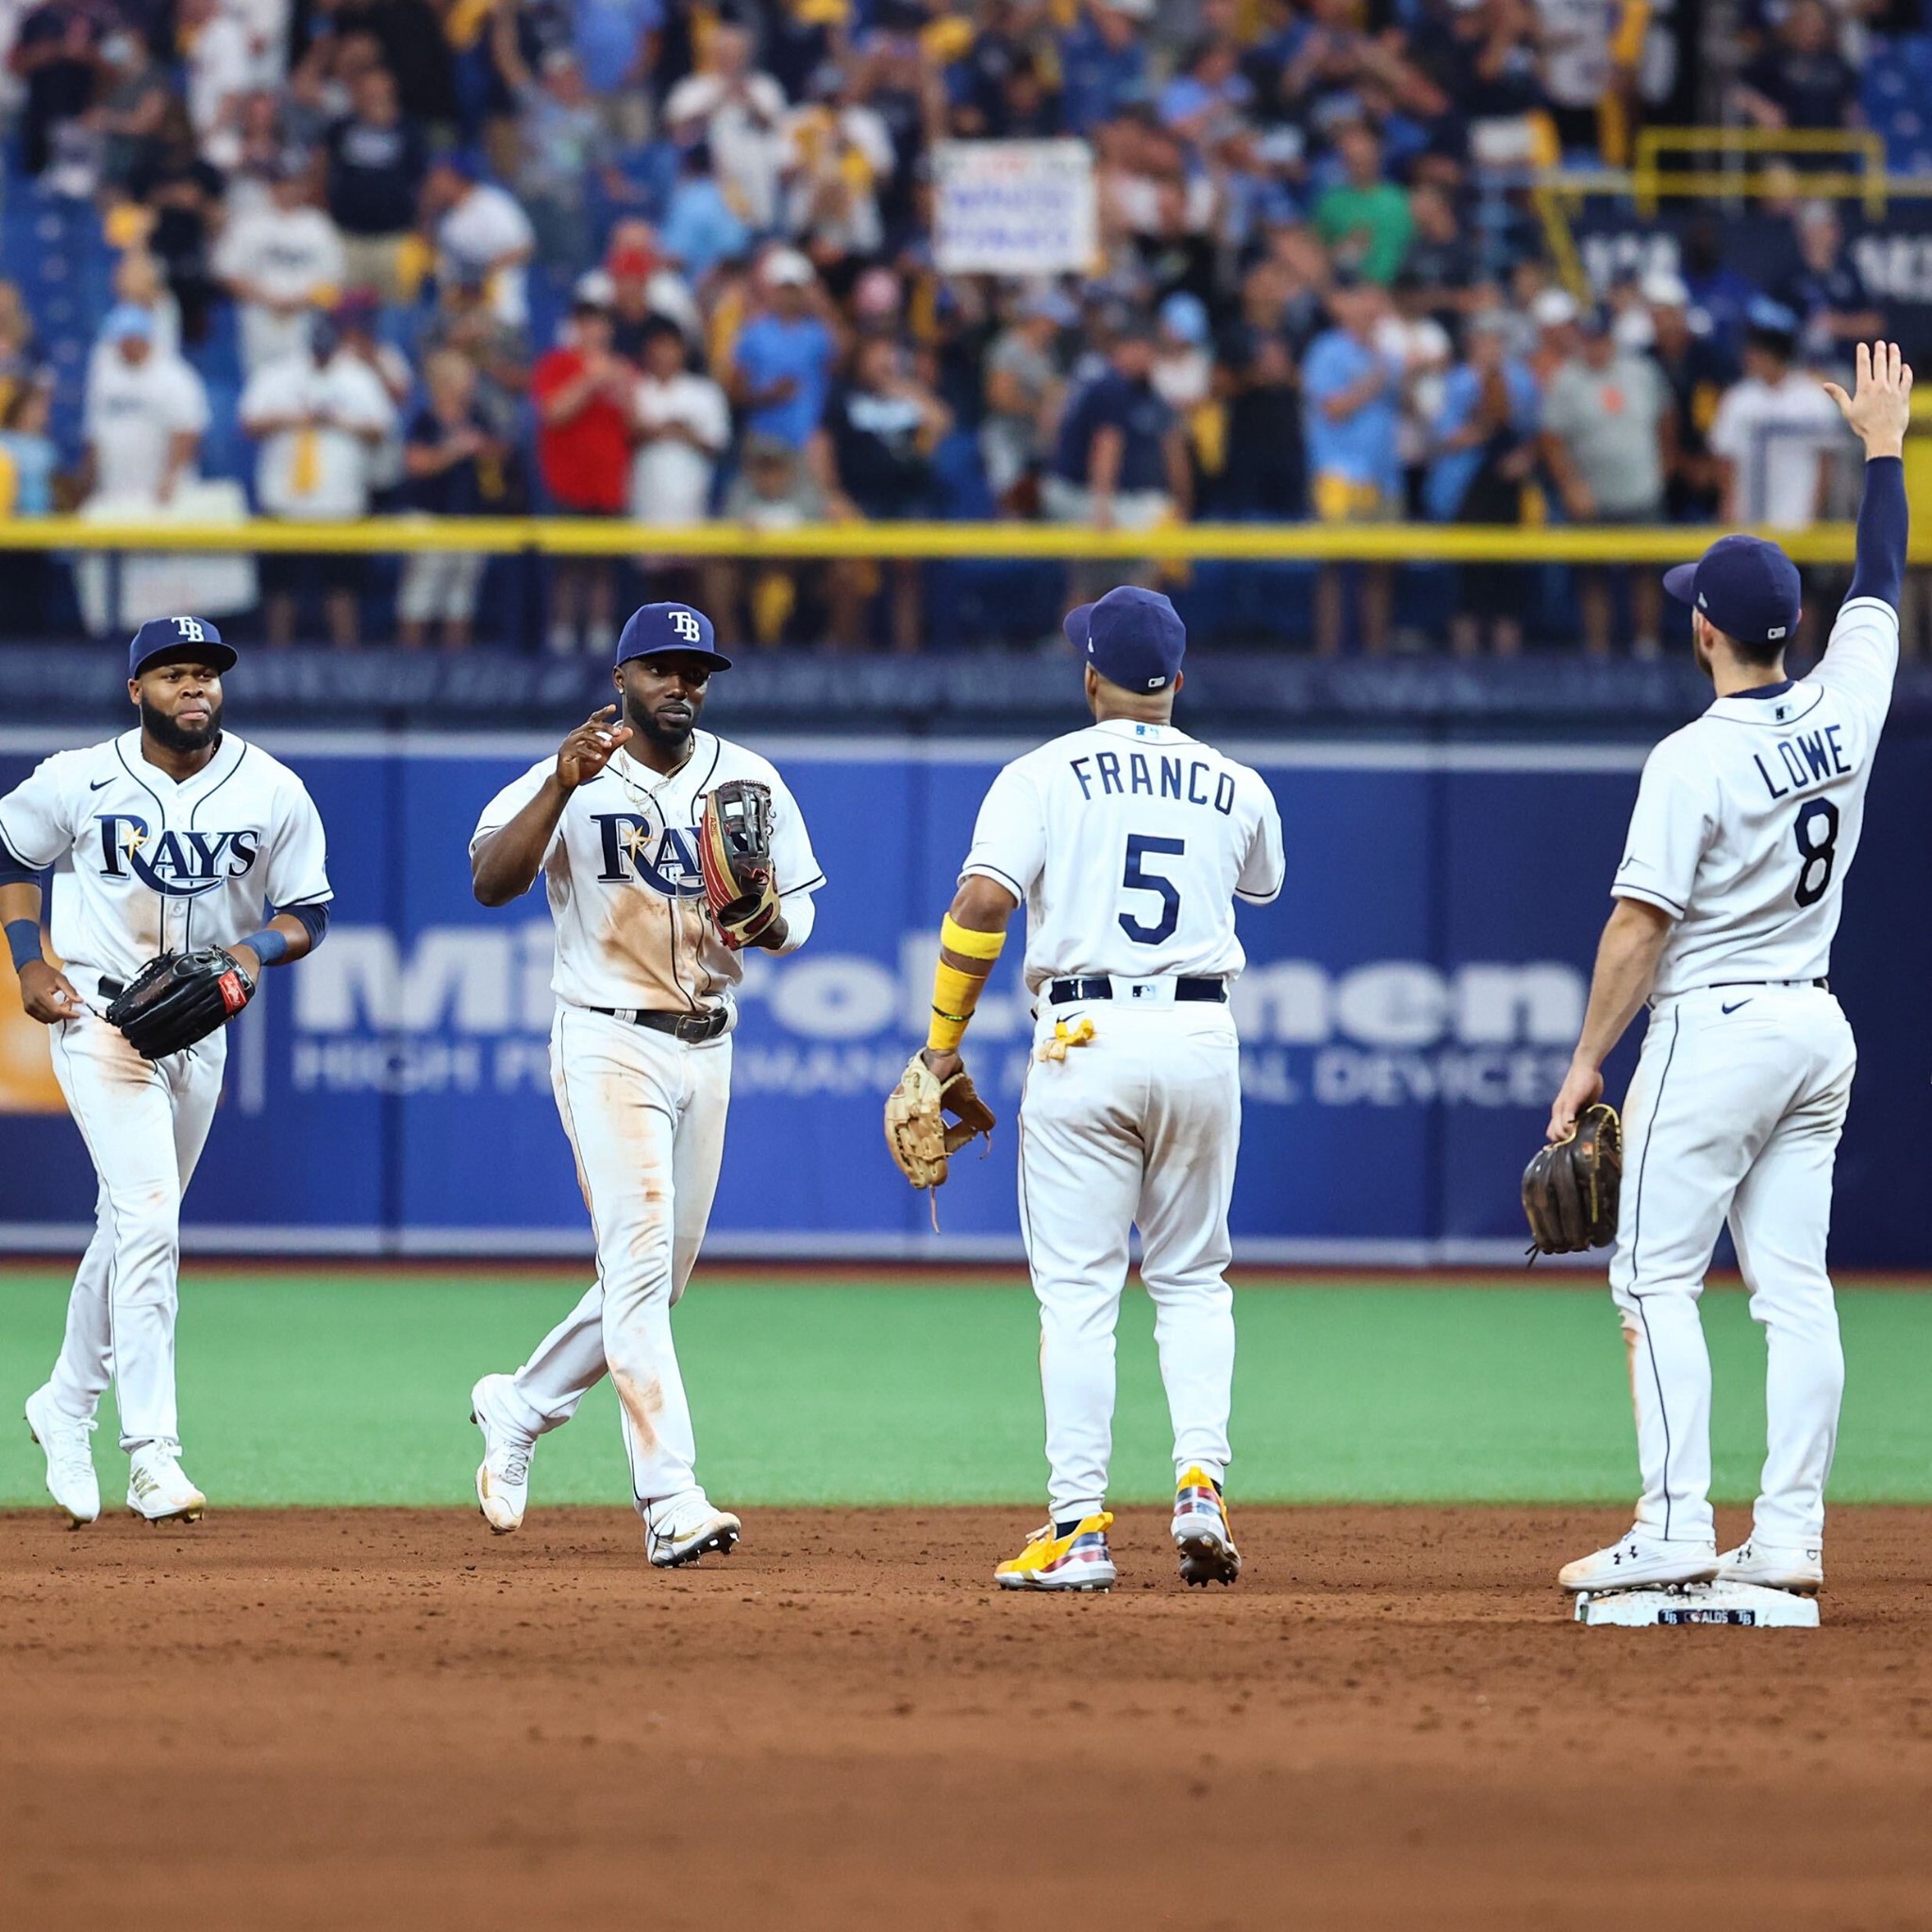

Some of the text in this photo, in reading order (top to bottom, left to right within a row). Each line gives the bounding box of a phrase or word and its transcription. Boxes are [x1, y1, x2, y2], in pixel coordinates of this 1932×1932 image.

[171, 616, 205, 641] TB
[667, 611, 700, 642] TB
[1070, 752, 1236, 816] FRANCO
[1754, 724, 1852, 800] LOWE
[93, 813, 260, 897] RAYS
[1794, 796, 1840, 908] 8
[1118, 833, 1185, 945] 5
[1702, 1611, 1728, 1624] ALDS
